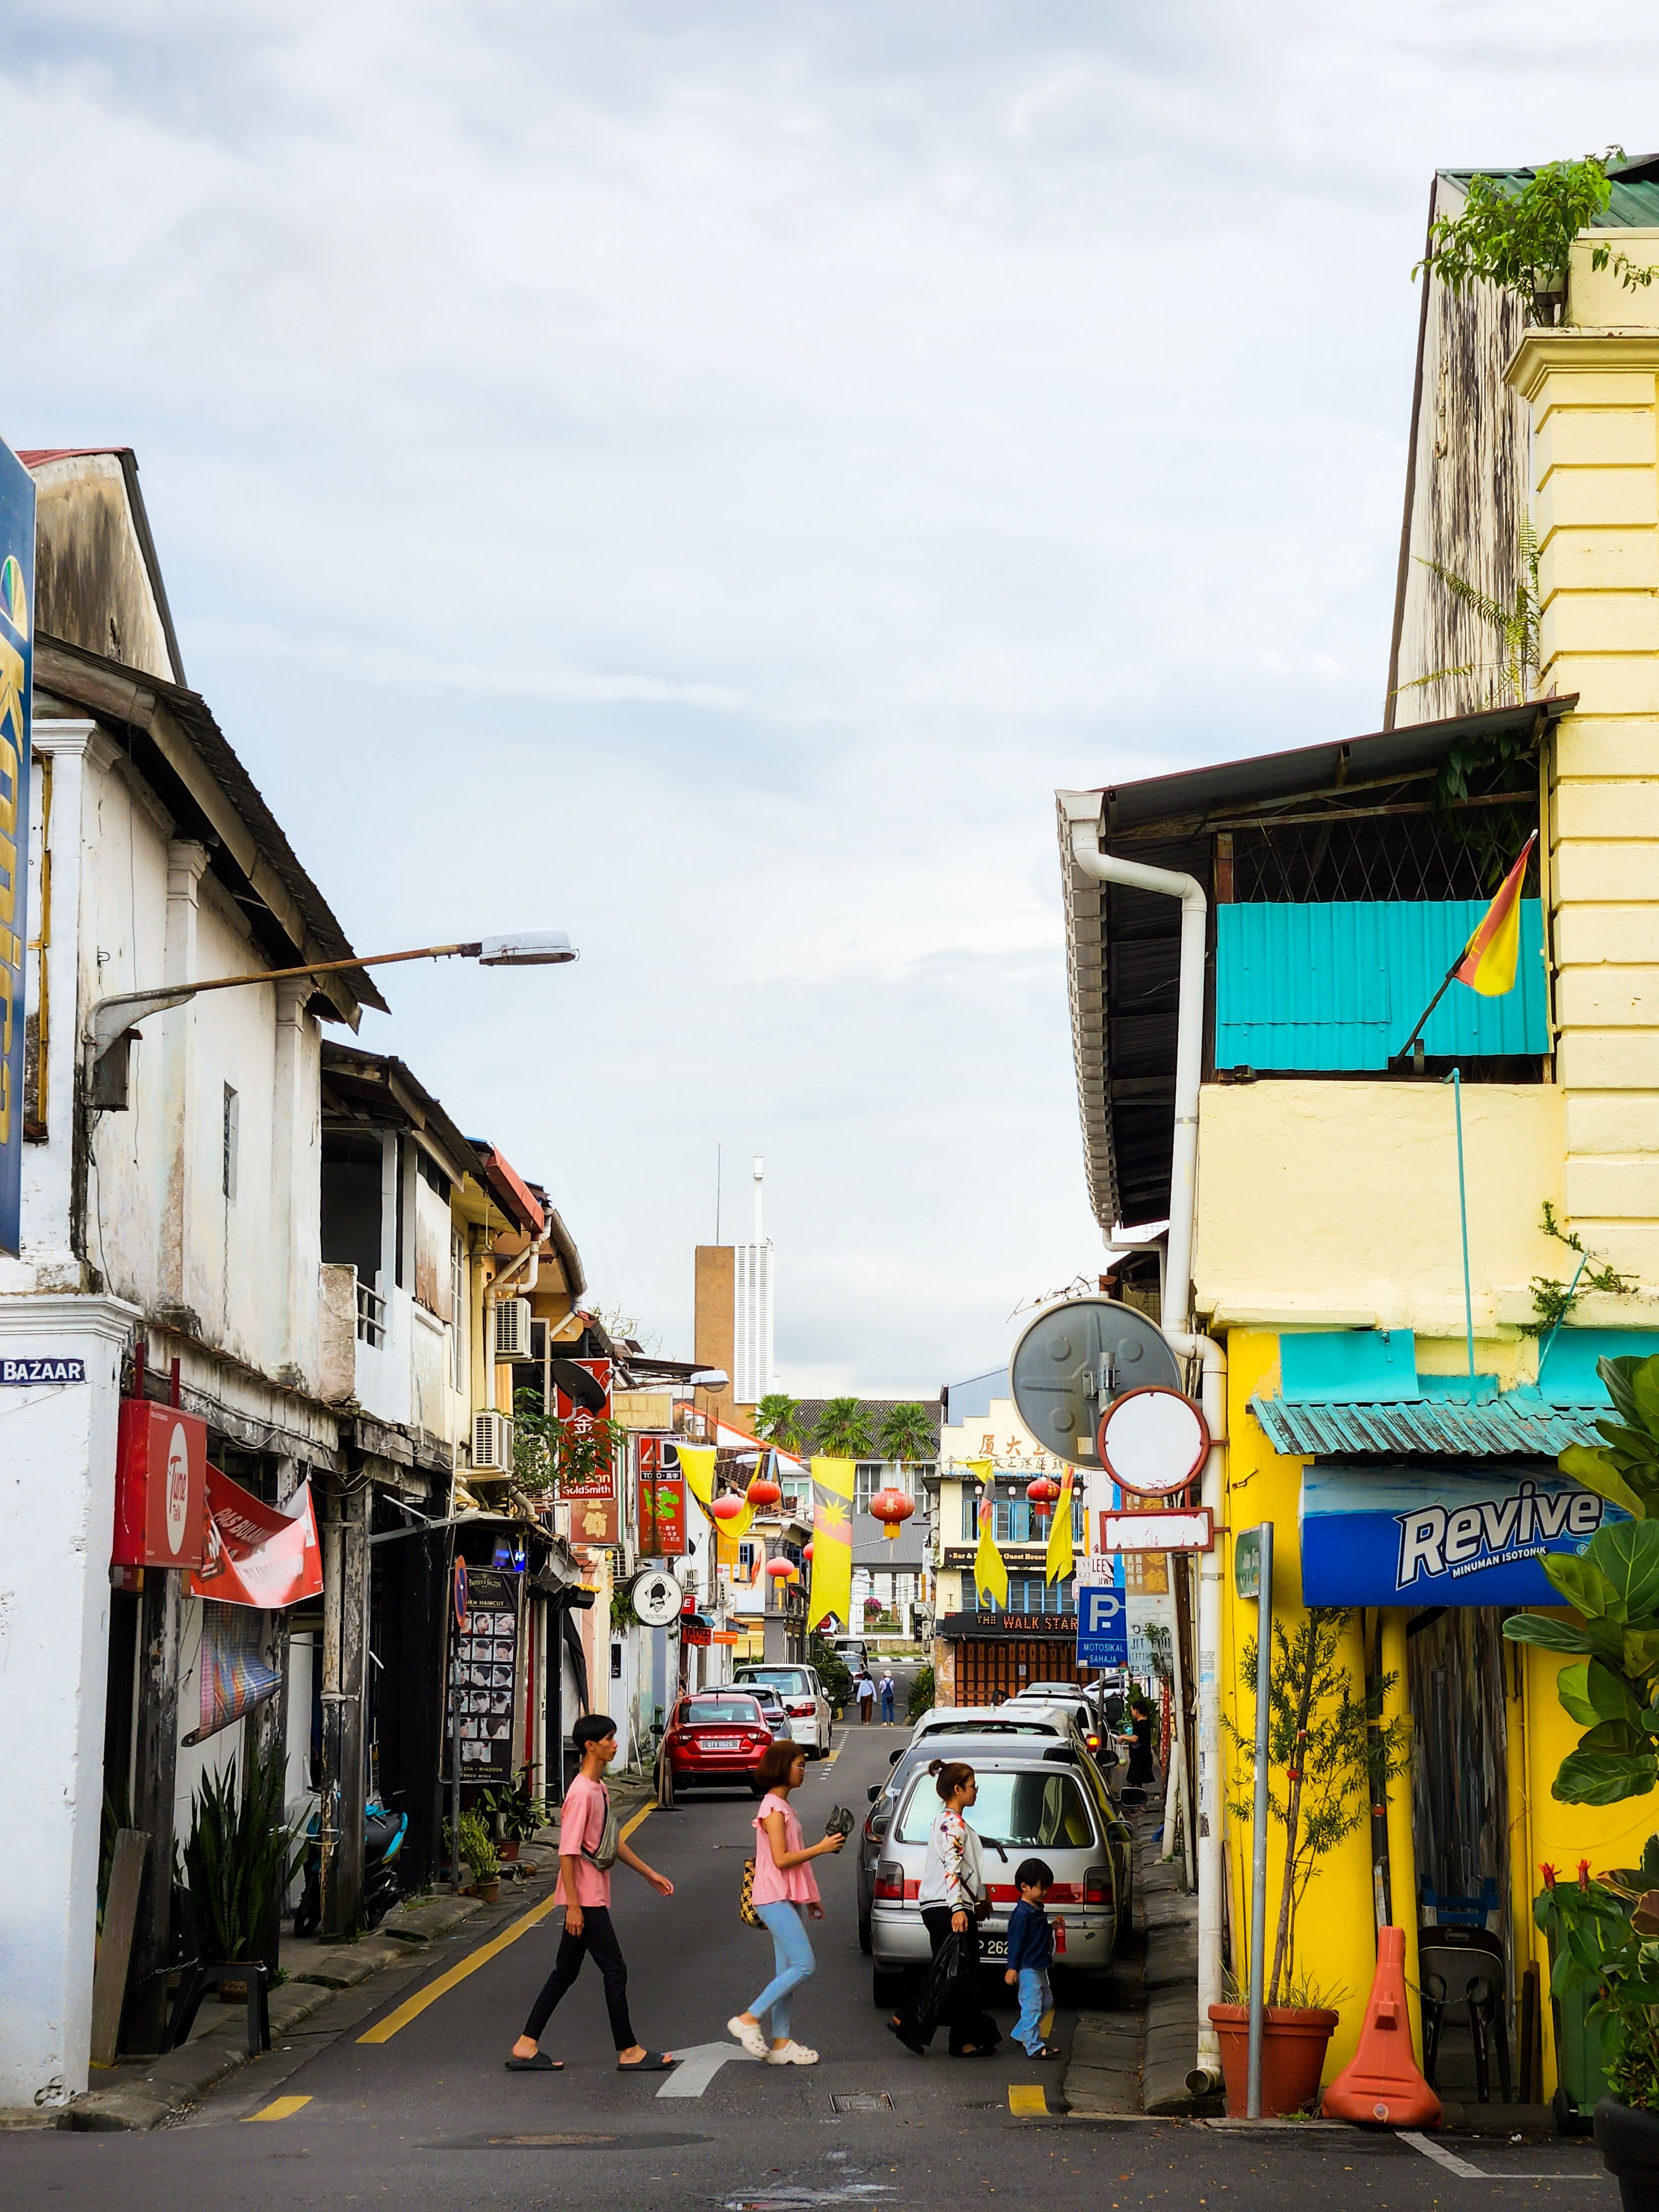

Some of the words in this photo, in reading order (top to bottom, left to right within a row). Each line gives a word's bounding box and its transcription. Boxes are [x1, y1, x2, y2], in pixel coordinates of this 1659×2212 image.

[4, 1360, 81, 1380] BAZAAR
[641, 1440, 680, 1468] 4D
[563, 1485, 611, 1494] GoldSmith
[1395, 1481, 1601, 1589] Revive
[1092, 1559, 1105, 1572] LEE
[1452, 1554, 1499, 1578] MINUMAN
[1502, 1546, 1547, 1563] ISOTONIK
[1089, 1594, 1119, 1631] P
[977, 1615, 996, 1625] THE
[1003, 1615, 1039, 1629] WALK
[685, 1628, 711, 1637] TATTOO
[1083, 1643, 1124, 1652] MOTOSIKAL
[1089, 1655, 1117, 1663] SAHAJA
